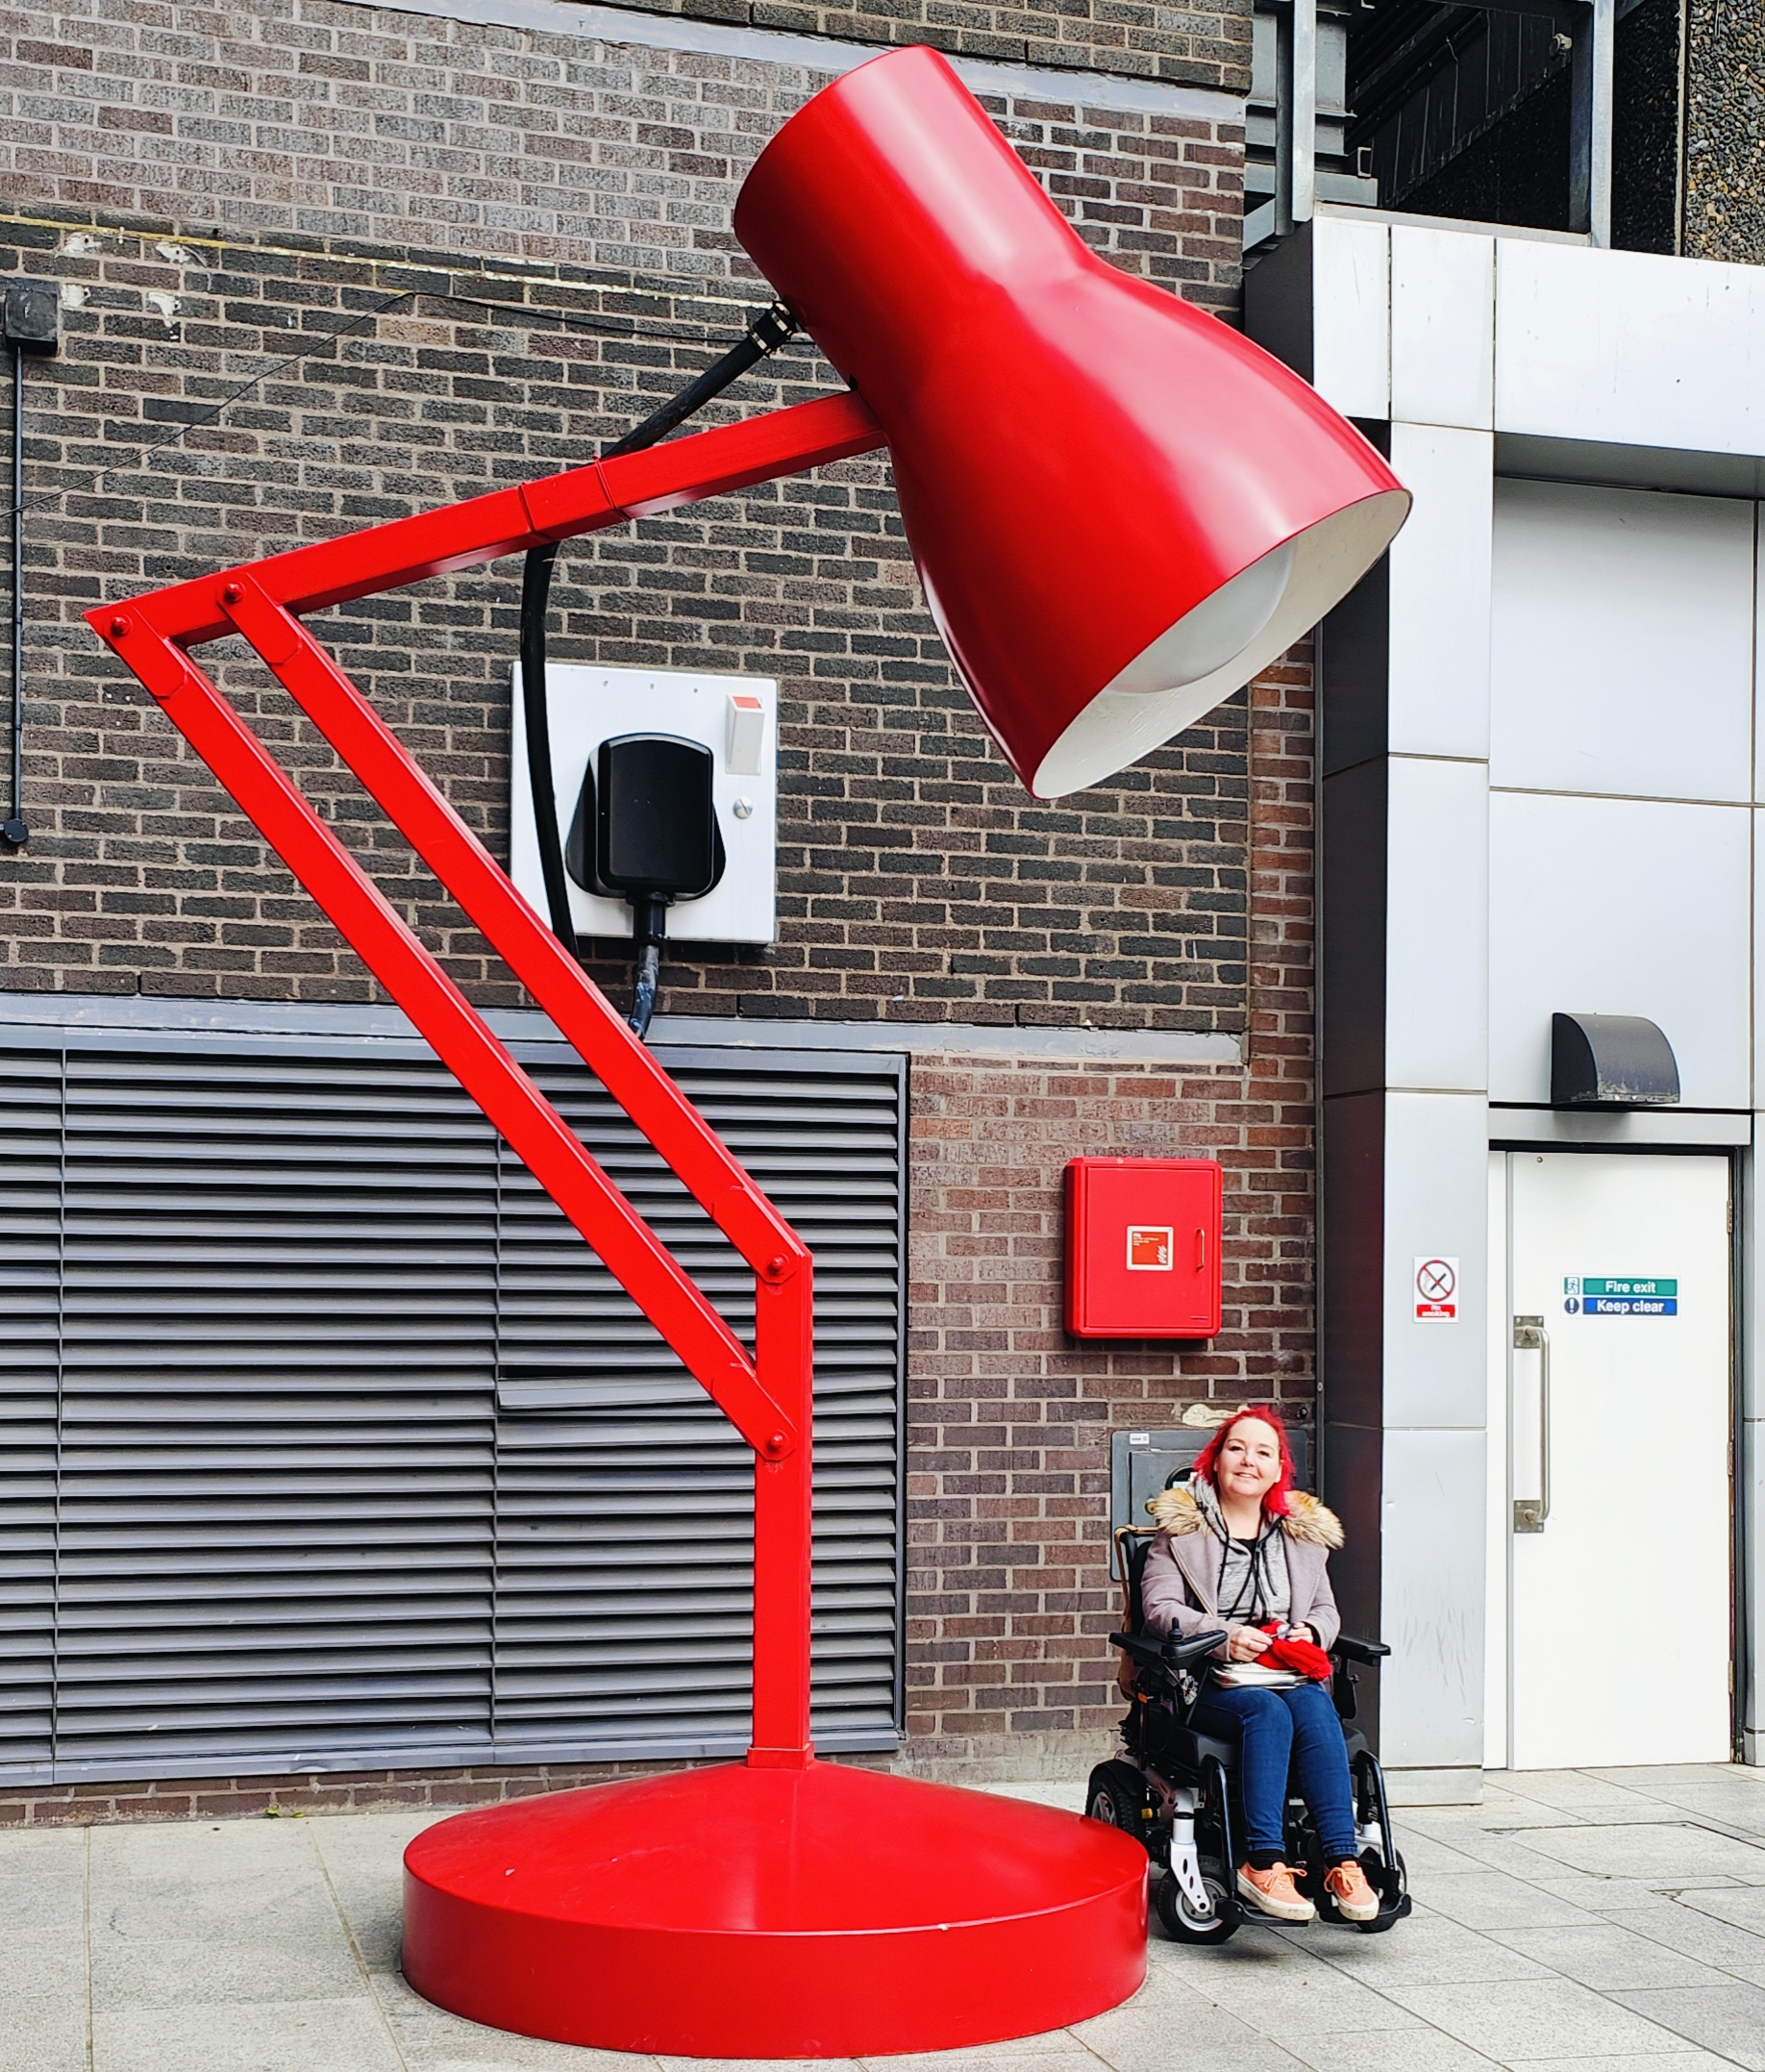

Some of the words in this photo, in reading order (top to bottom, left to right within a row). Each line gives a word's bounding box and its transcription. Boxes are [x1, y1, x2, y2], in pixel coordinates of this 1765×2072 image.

[1605, 1281, 1630, 1293] Fire
[1633, 1282, 1656, 1293] exit
[1597, 1300, 1629, 1314] Keep
[1632, 1300, 1665, 1312] clear
